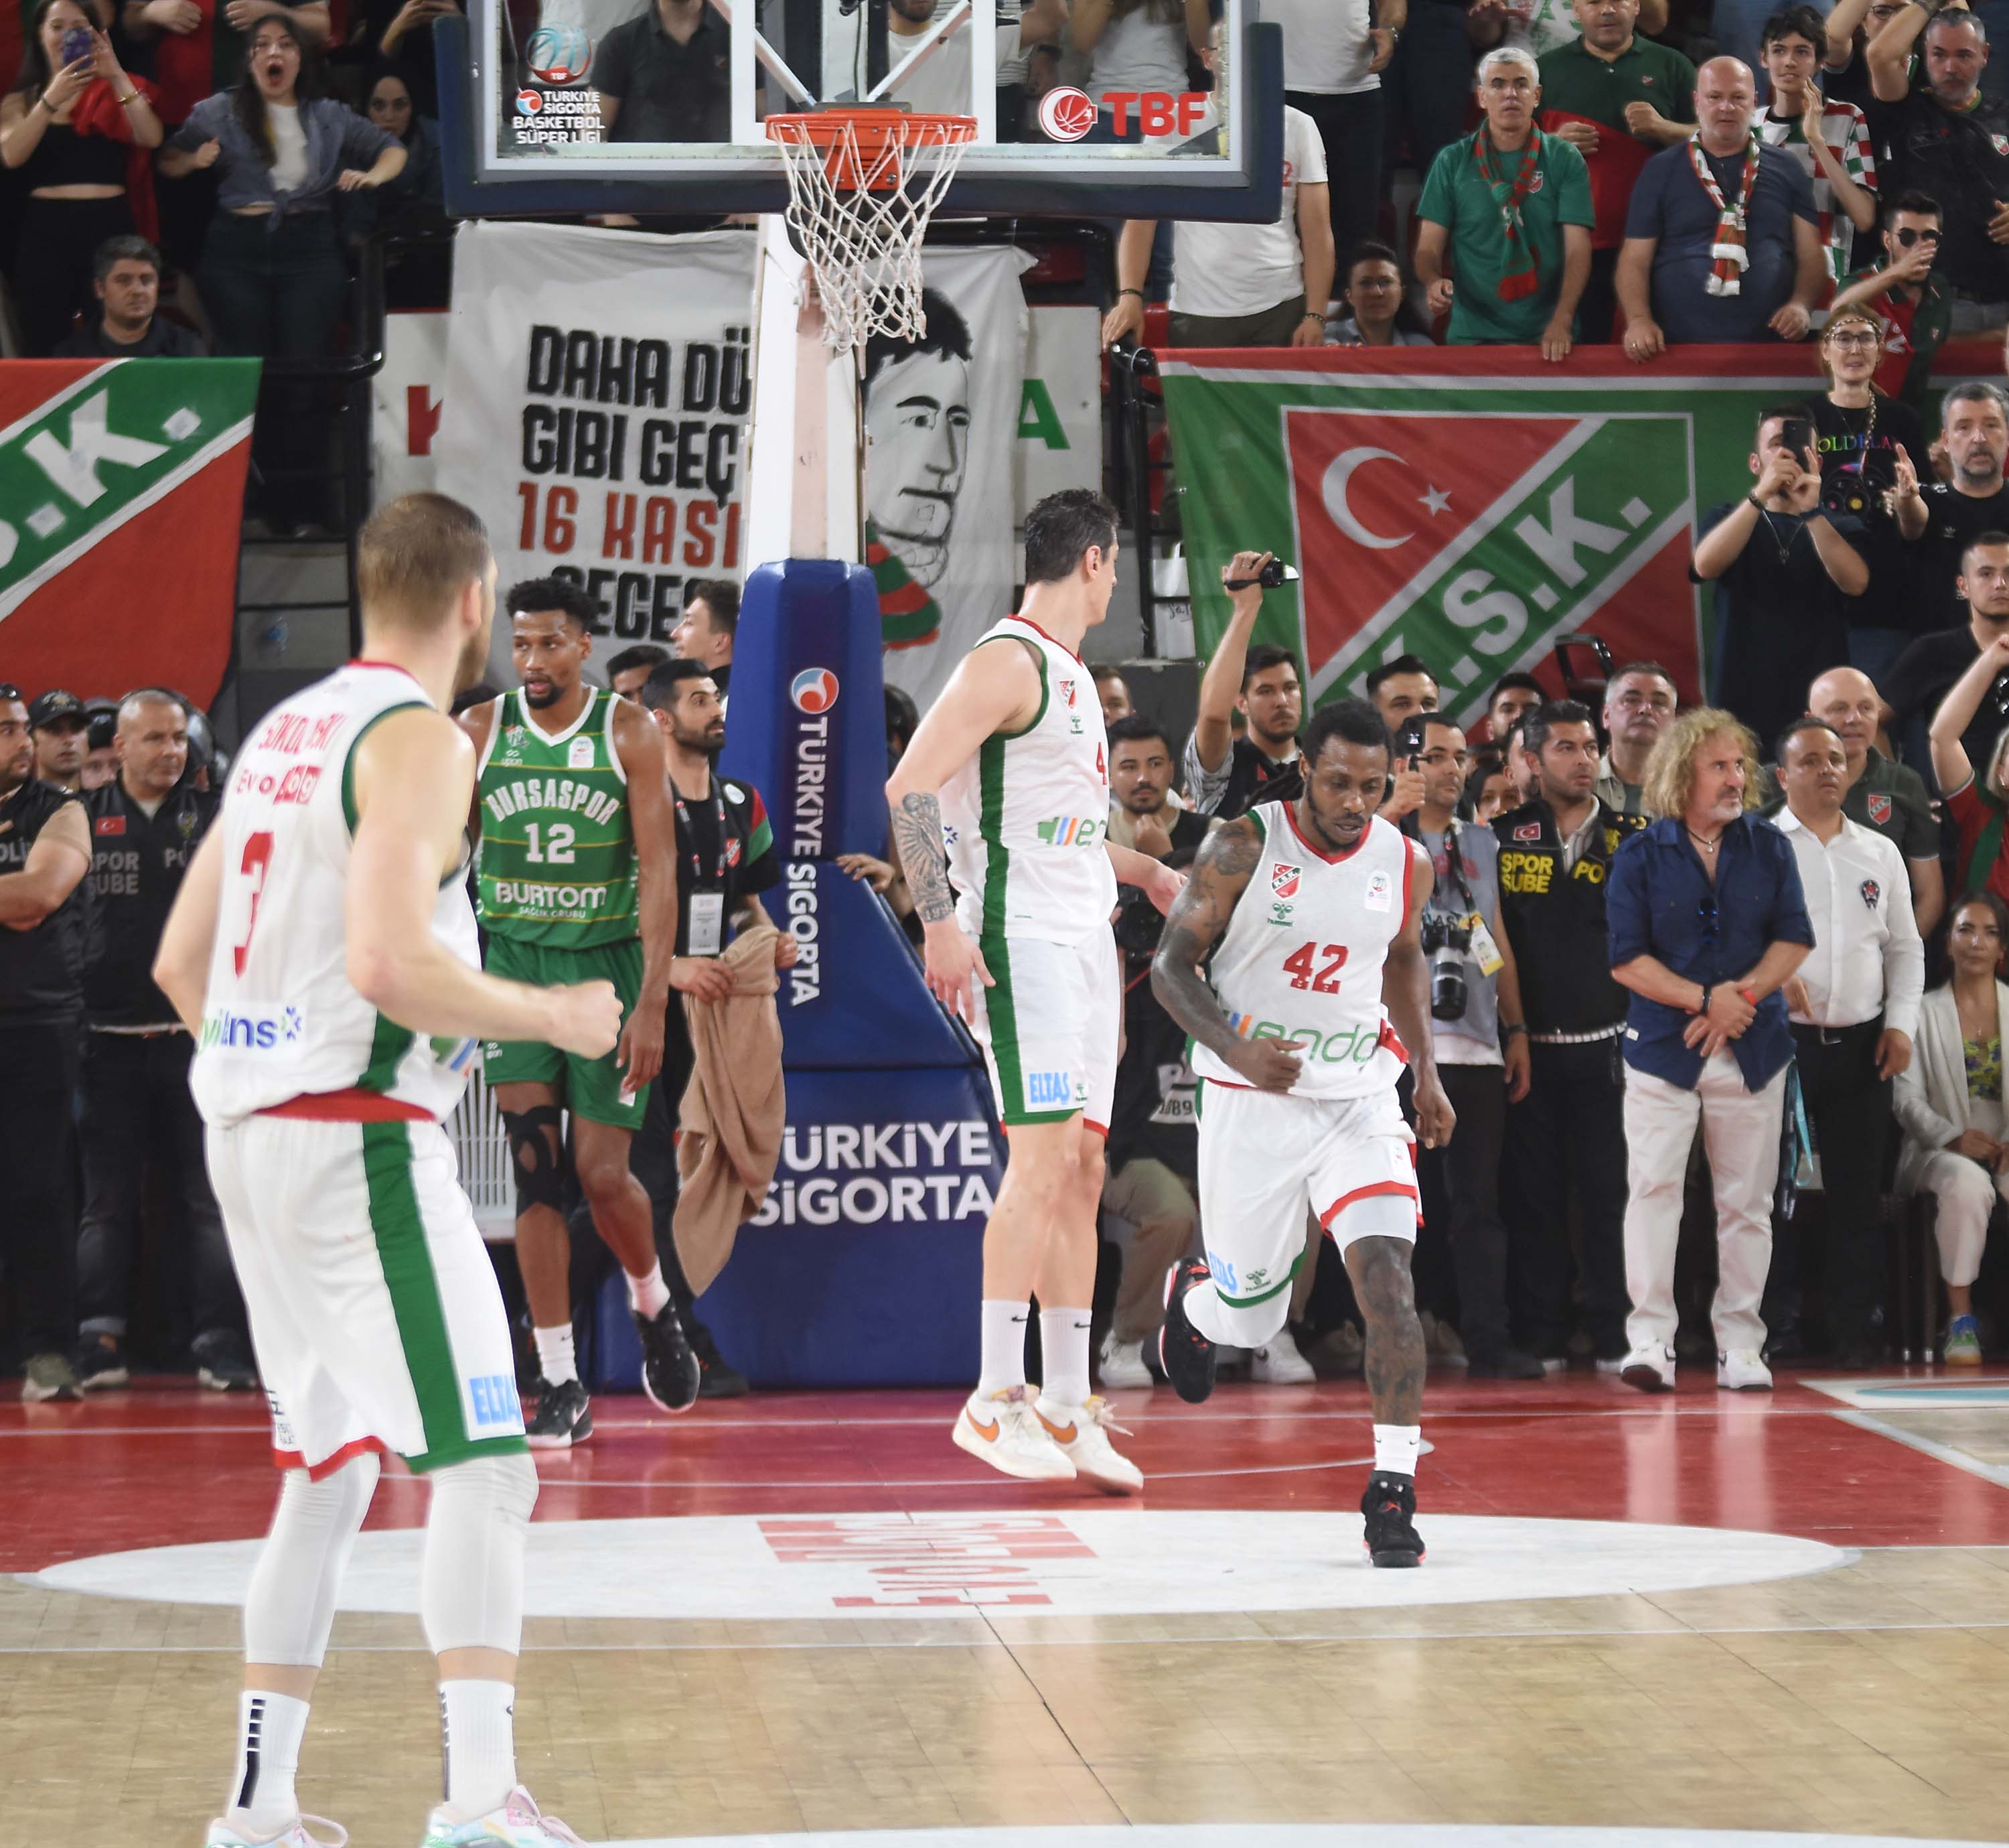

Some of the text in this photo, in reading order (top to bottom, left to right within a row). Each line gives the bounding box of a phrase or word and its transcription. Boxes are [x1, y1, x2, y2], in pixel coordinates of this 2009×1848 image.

[512, 117, 605, 129] BASKETBOL
[516, 129, 569, 144] SÜPER
[1102, 92, 1207, 137] TBF
[526, 324, 670, 409] DAHA
[518, 482, 579, 555] 16
[486, 778, 620, 825] BURSASPOR
[524, 823, 575, 863] 12
[1501, 853, 1554, 875] SPOR
[495, 881, 607, 909] BURTOM
[1282, 941, 1350, 995] 42
[783, 1121, 992, 1172] ÜRKİYE
